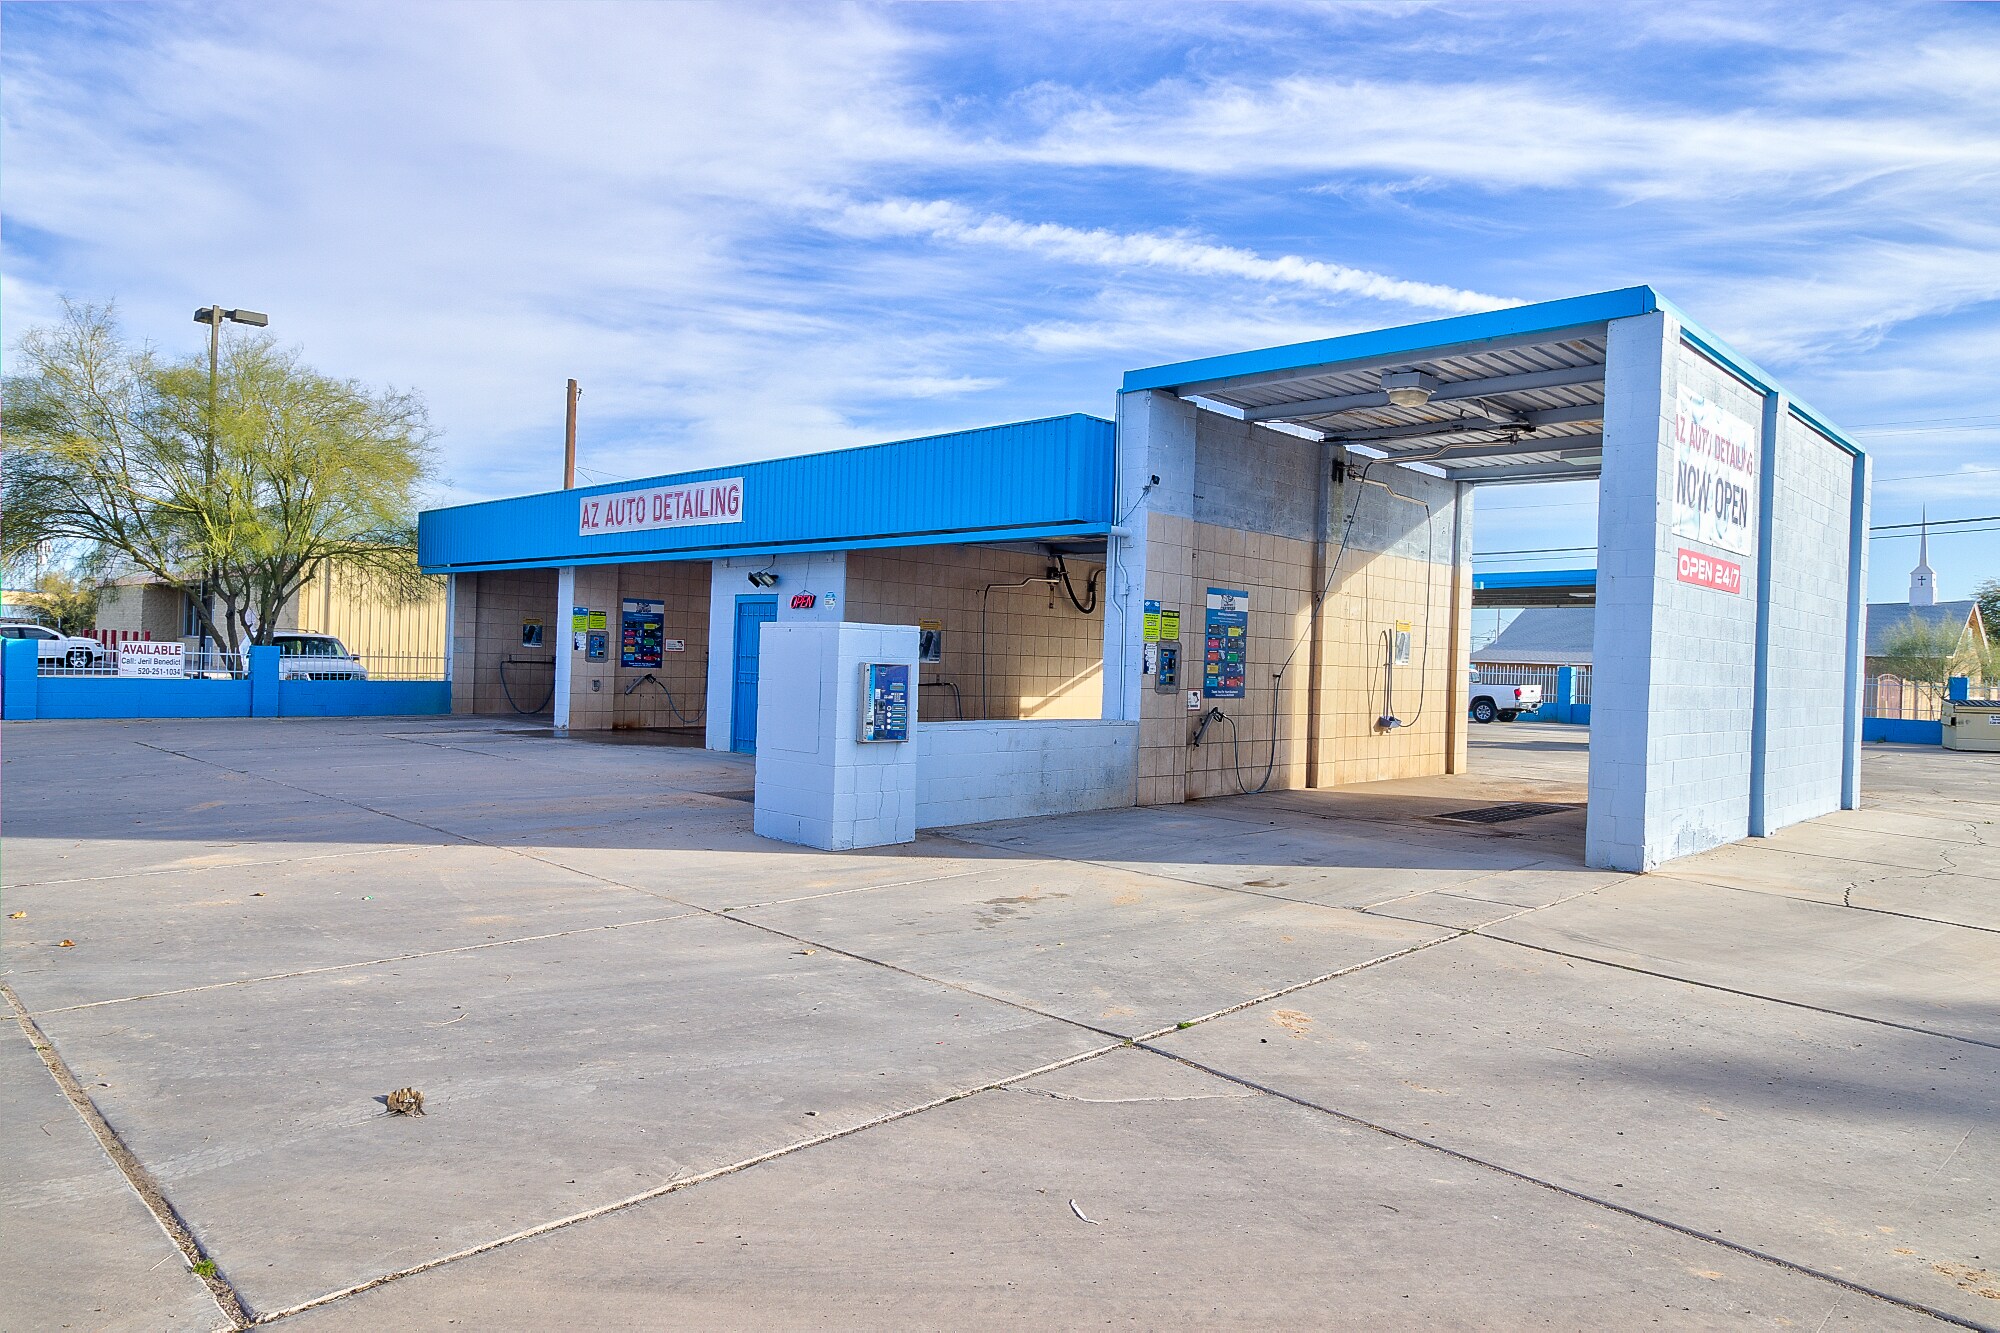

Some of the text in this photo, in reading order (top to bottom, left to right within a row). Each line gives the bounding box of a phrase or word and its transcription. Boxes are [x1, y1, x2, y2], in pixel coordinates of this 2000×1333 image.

[1677, 460, 1748, 528] NOW OPEN
[581, 485, 740, 529] AZ AUTO DETAILING
[1679, 554, 1740, 588] OPEN 24/7
[790, 595, 816, 609] OPEN
[122, 644, 182, 656] AVAILABLE
[121, 657, 137, 665] Call:
[153, 658, 181, 666] Benedict
[137, 667, 181, 676] 520-251-1034
